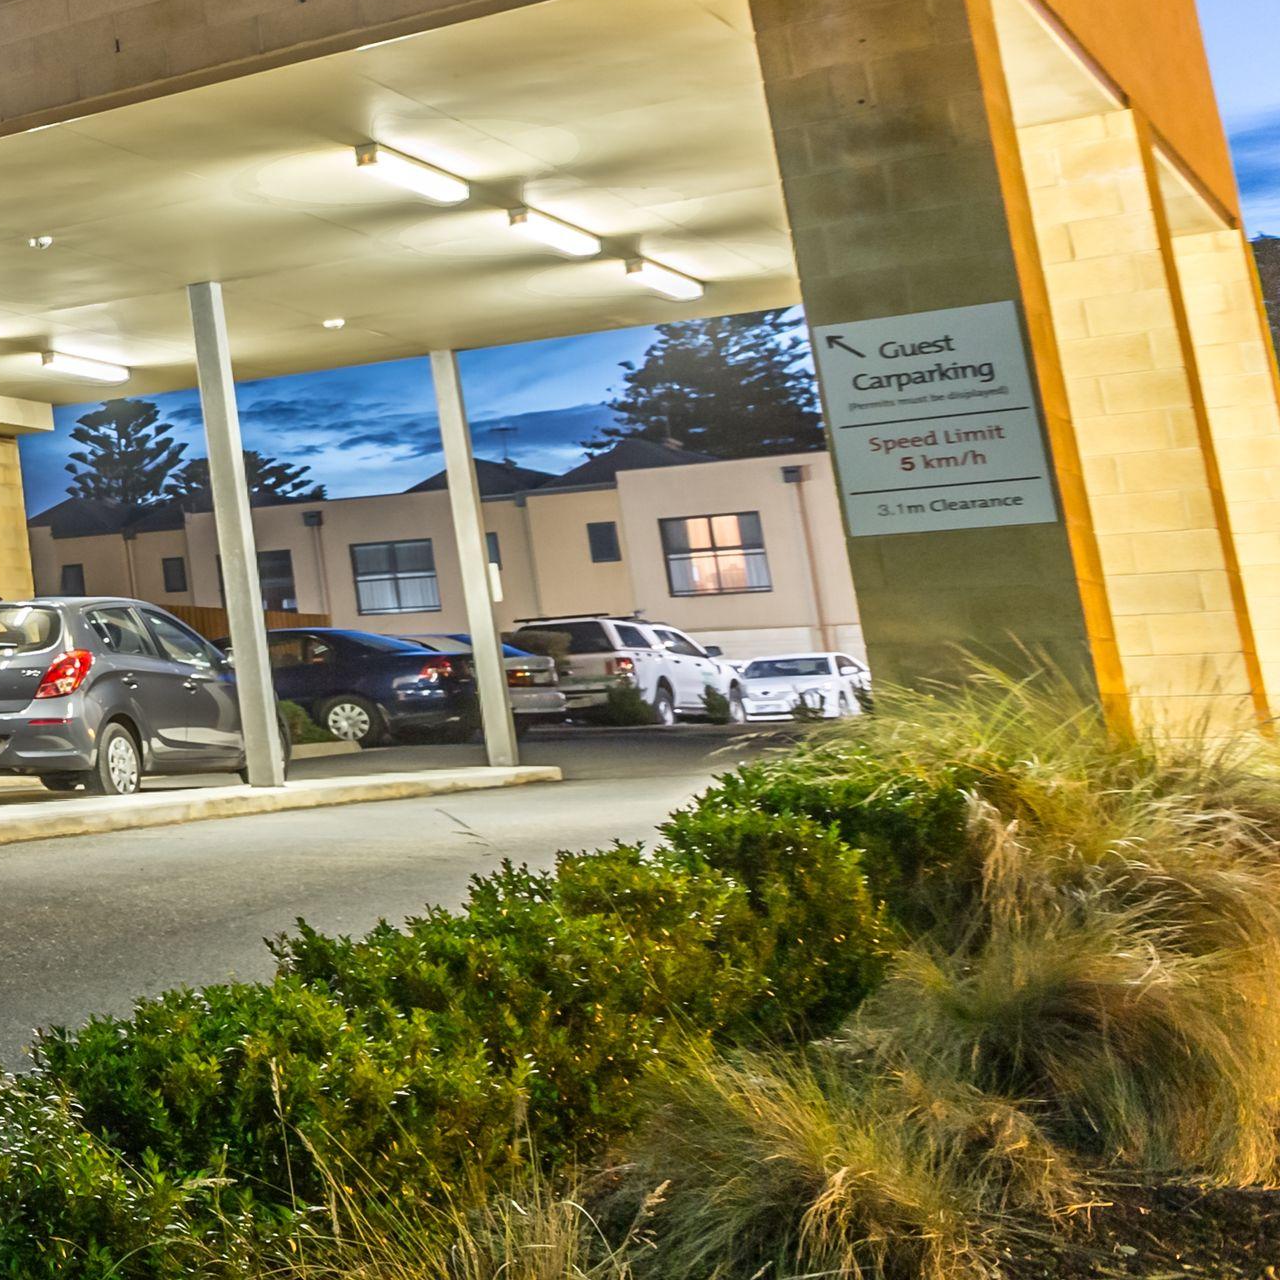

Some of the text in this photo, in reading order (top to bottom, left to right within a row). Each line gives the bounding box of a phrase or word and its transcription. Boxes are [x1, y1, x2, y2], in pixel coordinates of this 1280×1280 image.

[878, 335, 956, 360] Guest
[851, 362, 996, 391] Carparking
[868, 425, 1006, 455] Speed Limit
[900, 450, 988, 472] 5 km/h
[928, 495, 1025, 513] Clearance
